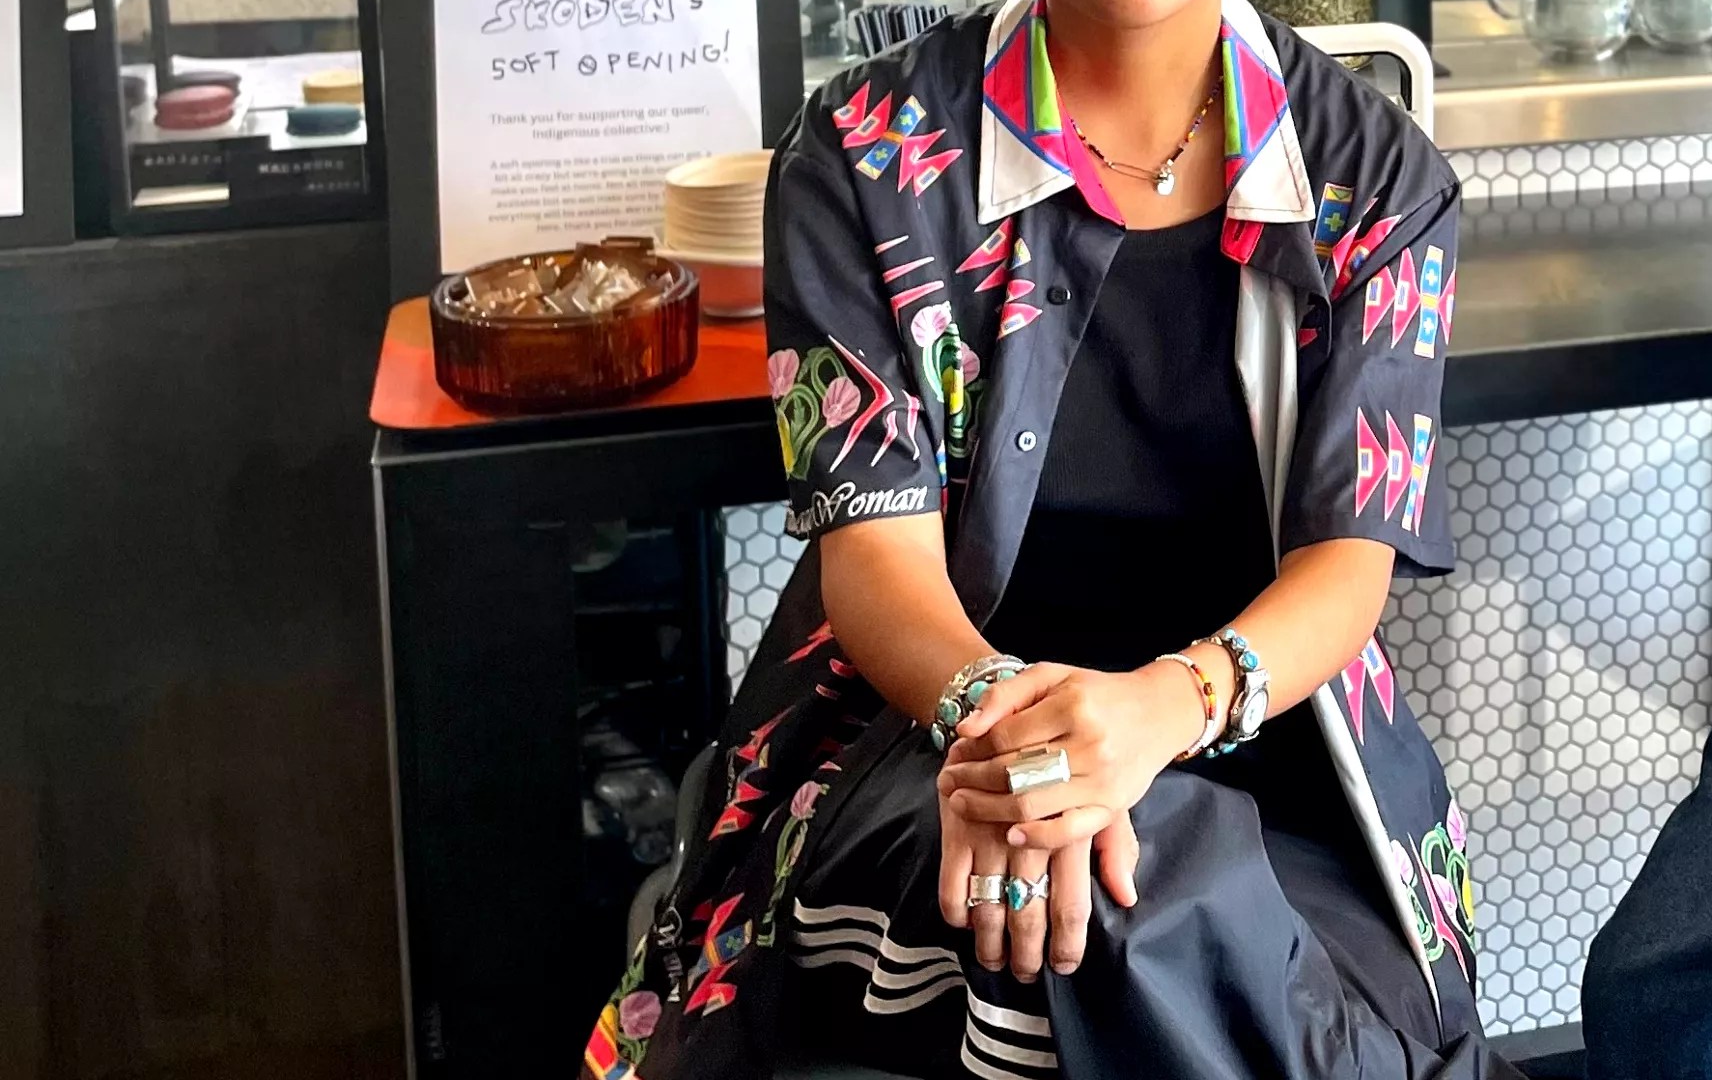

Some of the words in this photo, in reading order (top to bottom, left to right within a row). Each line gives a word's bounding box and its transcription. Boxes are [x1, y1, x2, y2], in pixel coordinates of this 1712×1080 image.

[492, 49, 560, 81] SOFT
[577, 28, 730, 77] OPENING!
[490, 112, 528, 125] Thank
[530, 114, 555, 127] you
[556, 109, 575, 122] for
[577, 106, 645, 123] supporting
[647, 107, 667, 118] our
[532, 125, 600, 141] Indigenous
[811, 481, 928, 528] Woman
